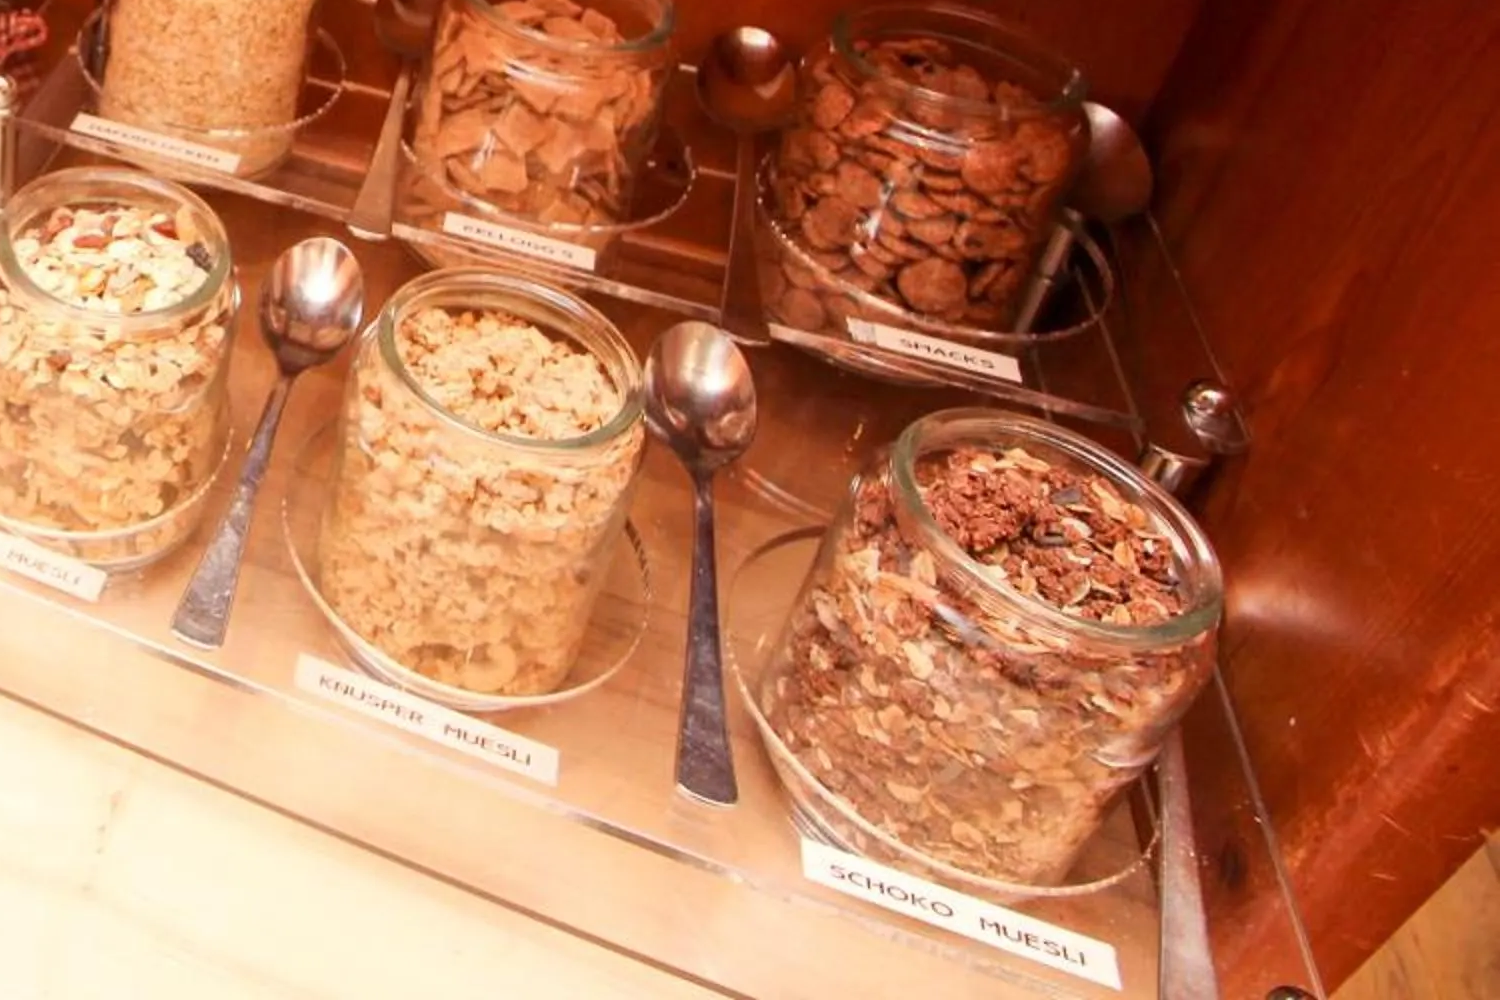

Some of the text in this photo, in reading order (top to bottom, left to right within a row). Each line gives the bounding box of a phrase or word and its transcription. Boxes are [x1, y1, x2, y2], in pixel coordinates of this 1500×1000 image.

[900, 338, 996, 370] SMACKS
[6, 548, 82, 586] MUESLI
[318, 674, 532, 767] KNUSPER MUESLI
[828, 863, 1088, 967] SCHOKO MUESLI
